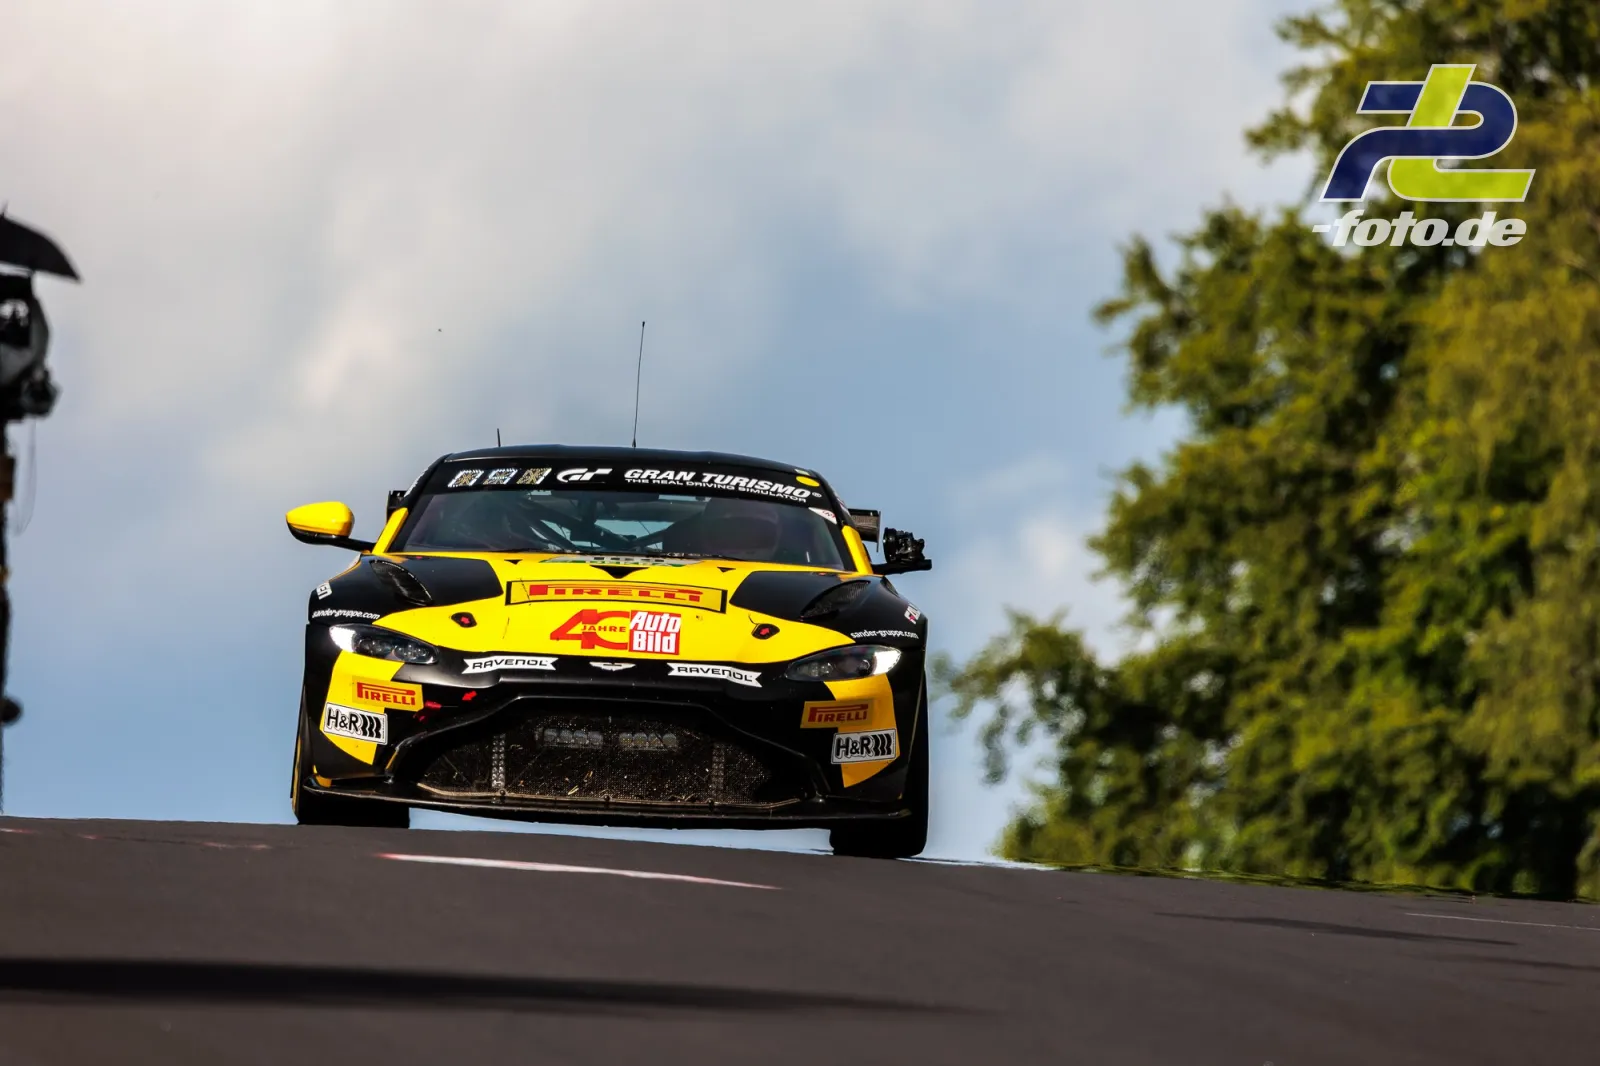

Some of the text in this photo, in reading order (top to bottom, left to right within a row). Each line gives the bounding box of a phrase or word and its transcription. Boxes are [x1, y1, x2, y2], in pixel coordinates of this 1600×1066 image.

[624, 469, 812, 499] GRAN TURISMO
[690, 481, 736, 491] DRIVING
[738, 486, 807, 503] SIMULATOR
[529, 584, 704, 603] PIRELLI
[311, 607, 381, 620] sander-gruppe.com
[630, 611, 682, 634] Auto
[581, 625, 627, 633] JAHRE
[850, 629, 920, 640] sander-gruppe.com
[632, 630, 676, 654] Bild
[471, 658, 549, 670] RAVENOL
[676, 665, 753, 682] RAVENOL
[356, 682, 416, 706] PIRELLI
[326, 706, 359, 733] H&R
[807, 703, 869, 723] PIRELLI
[835, 735, 872, 759] H&R
